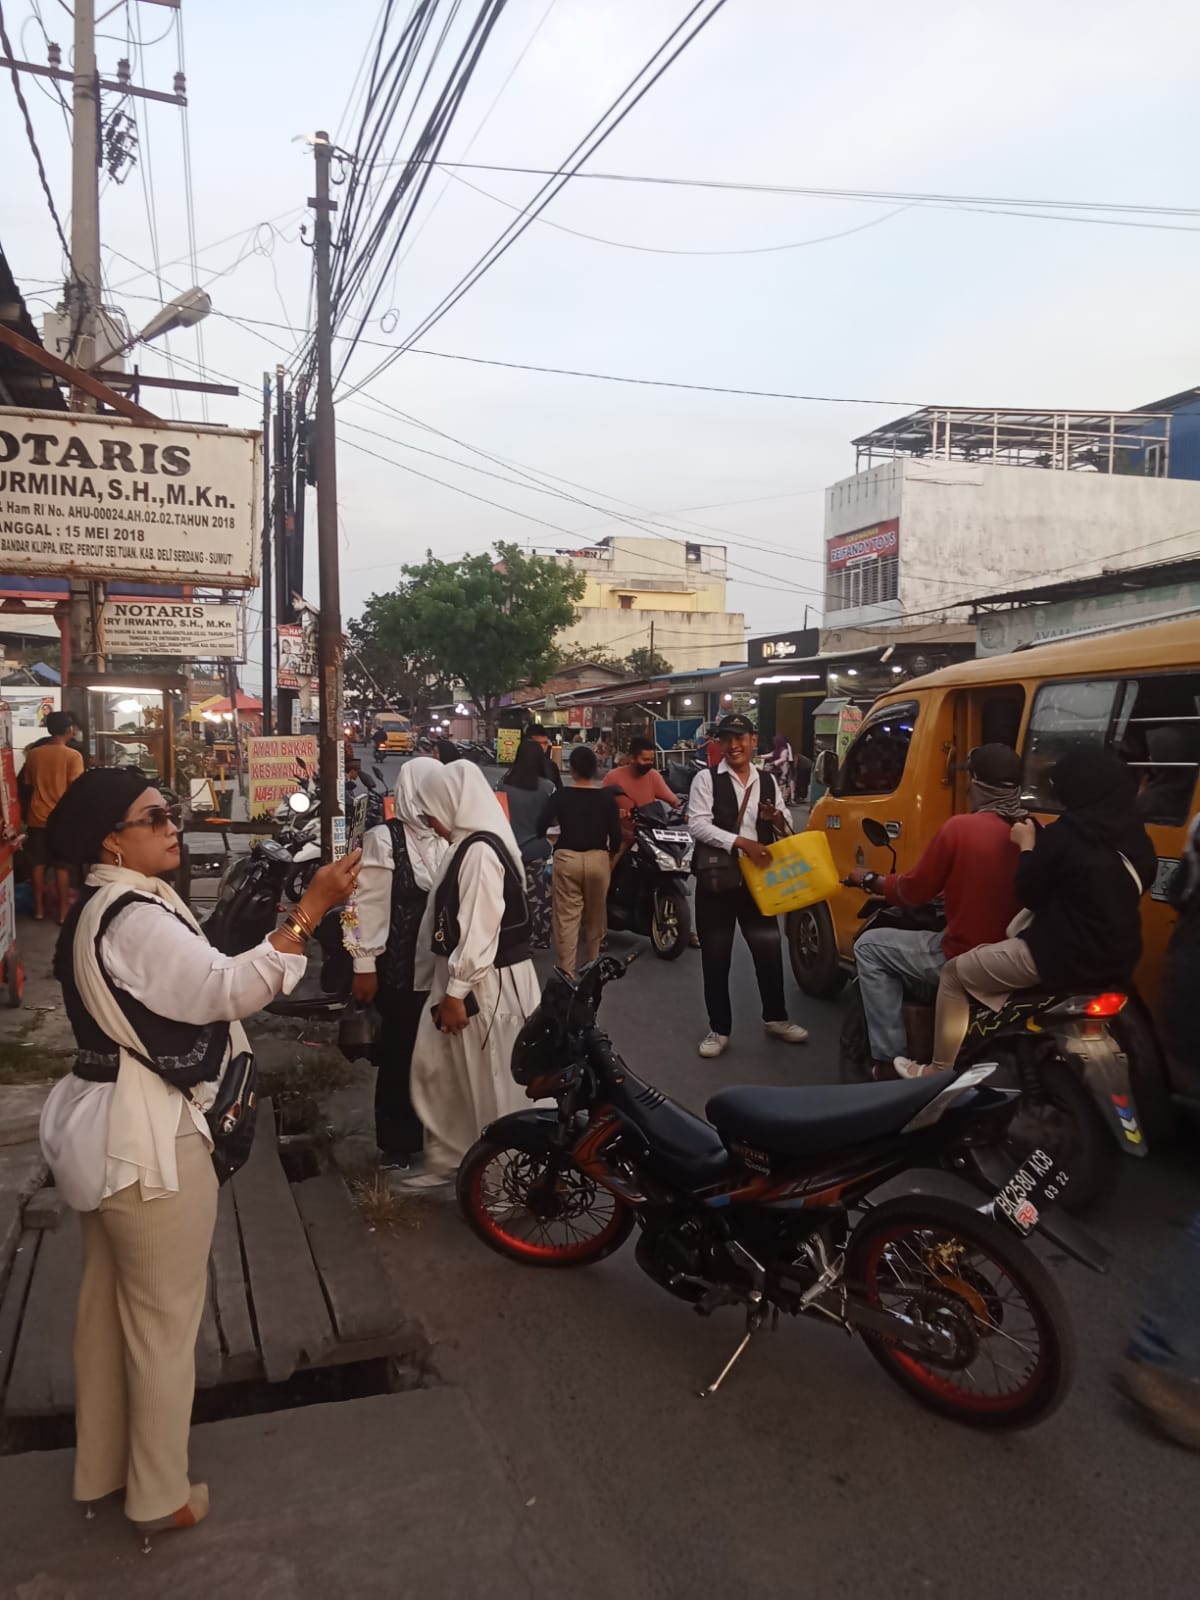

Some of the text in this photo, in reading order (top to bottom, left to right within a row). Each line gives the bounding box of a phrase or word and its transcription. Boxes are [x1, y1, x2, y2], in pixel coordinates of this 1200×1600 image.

[7, 500, 30, 515] Ham
[34, 503, 44, 516] RI
[48, 504, 65, 517] No.
[212, 516, 235, 529] 2018
[65, 525, 80, 538] 15
[85, 526, 109, 539] MEI
[113, 528, 145, 542] 2018
[1, 539, 30, 553] BANDAR
[77, 544, 104, 558] PERCUT
[157, 548, 173, 561] DELI
[174, 550, 204, 564] SERDANG
[209, 552, 234, 565] SUMUT
[115, 604, 204, 618] NOTARIS
[125, 617, 177, 628] IRWANTO,
[206, 620, 231, 629] M.Kn
[253, 740, 314, 757] AYAM BAKAR
[255, 785, 276, 802] NASI
[1028, 1149, 1054, 1177] ACB
[1044, 1170, 1070, 1200] 03 22
